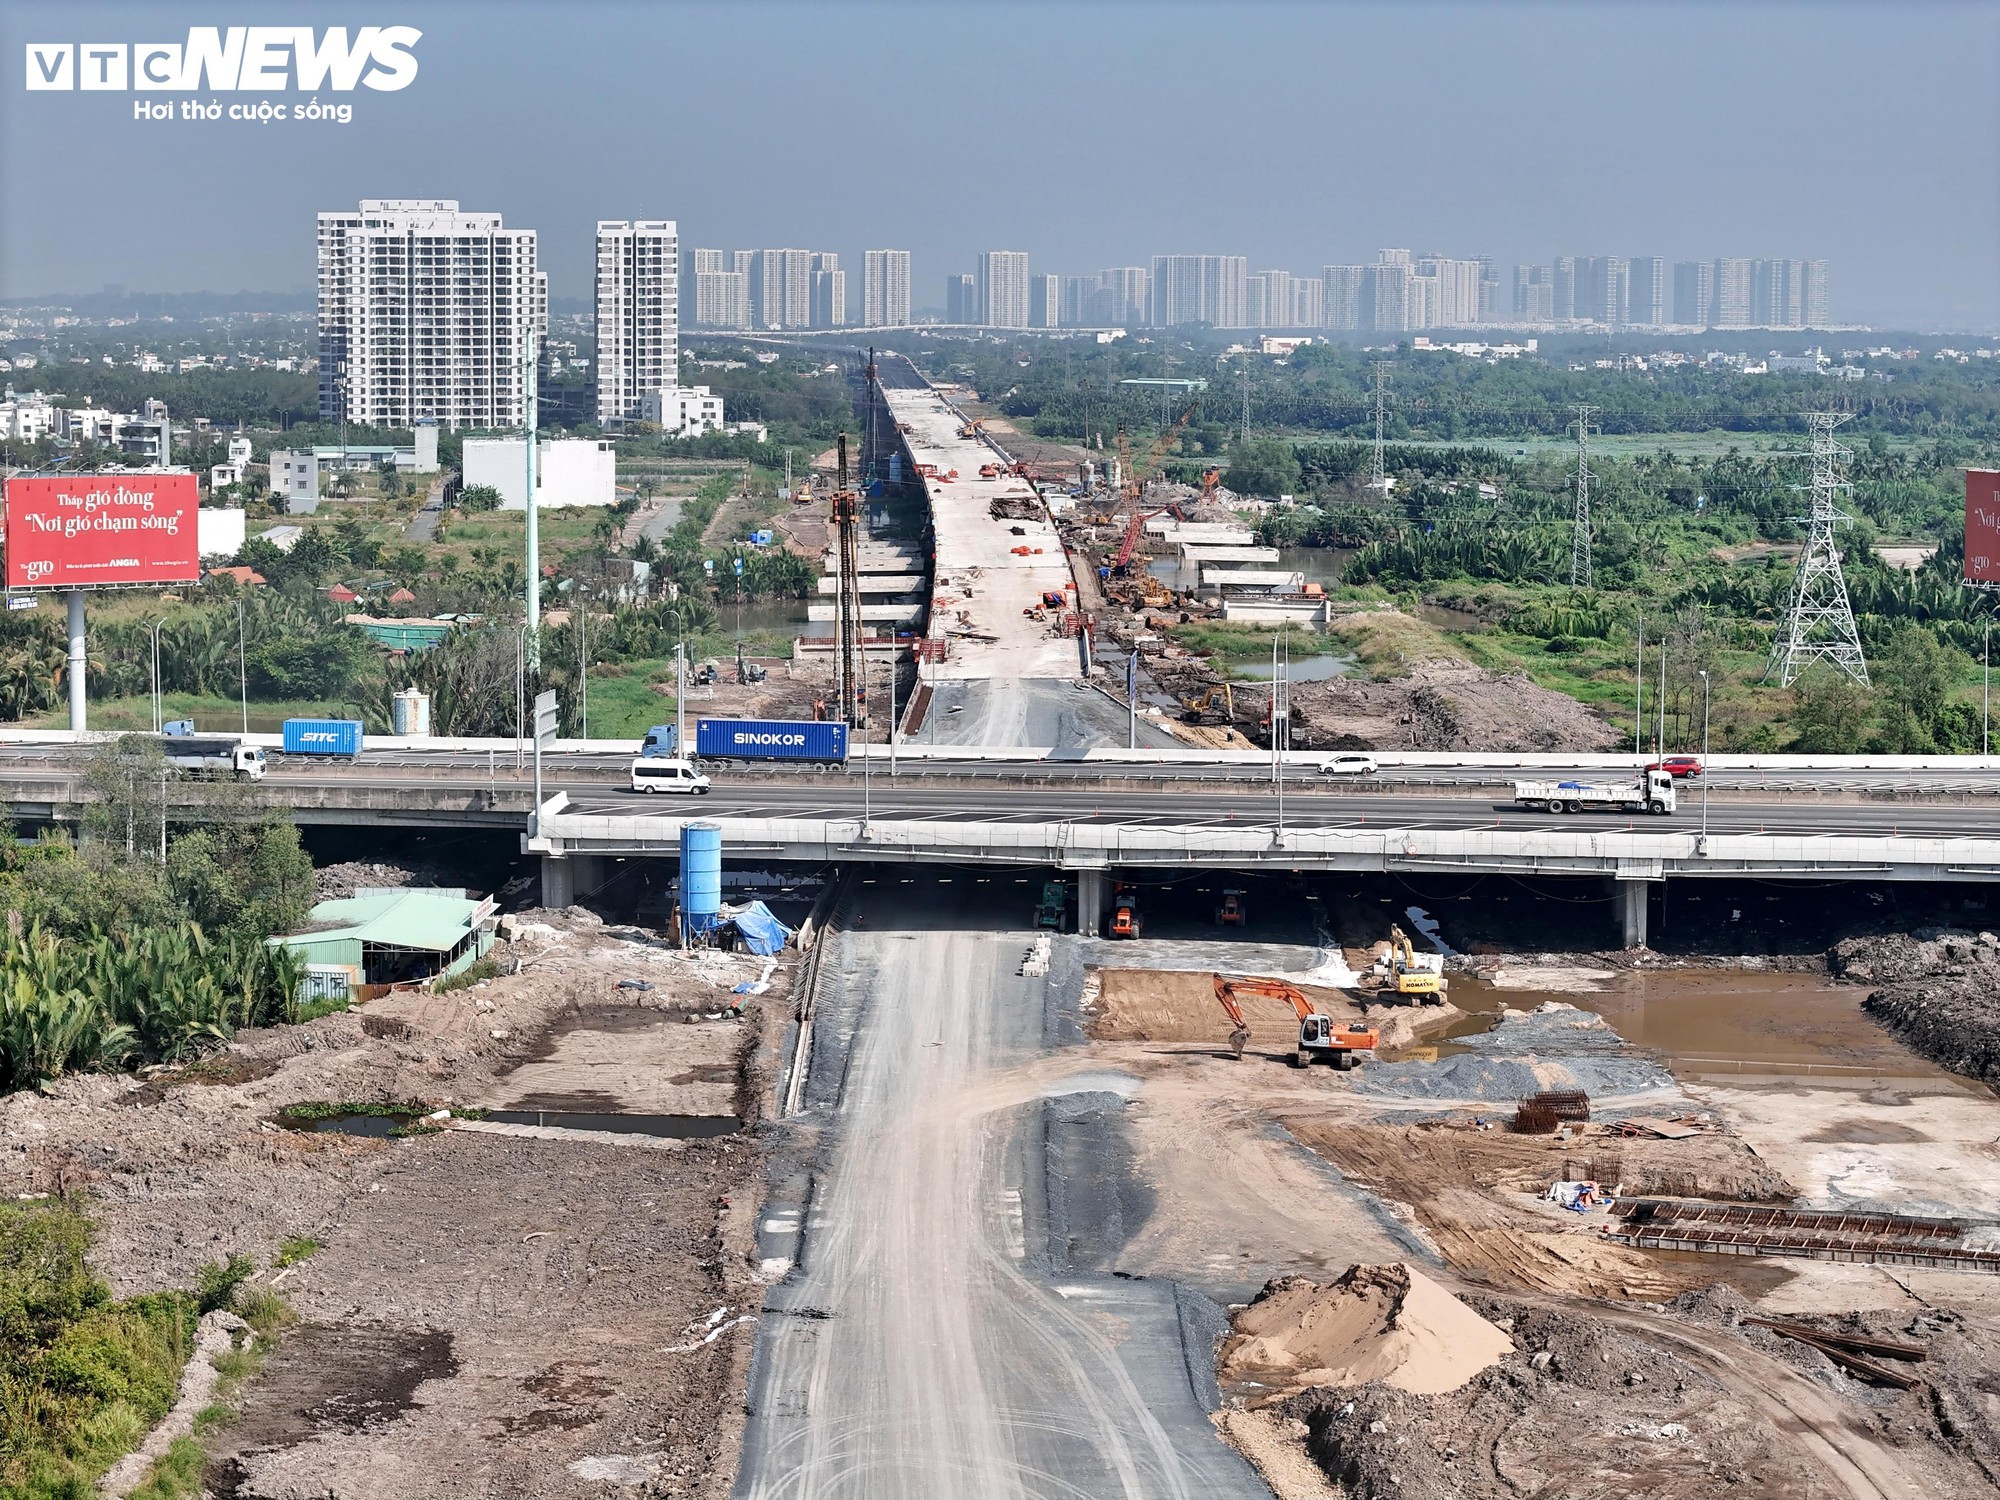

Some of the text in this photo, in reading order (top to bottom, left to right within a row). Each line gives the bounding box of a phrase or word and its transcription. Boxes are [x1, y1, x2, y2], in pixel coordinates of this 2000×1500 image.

[57, 486, 154, 513] Tháp gió đông
[65, 515, 91, 538] gió
[94, 511, 137, 533] chạm
[109, 559, 139, 567] ANGIA
[299, 732, 339, 742] SITC
[734, 733, 805, 746] SINOKOR
